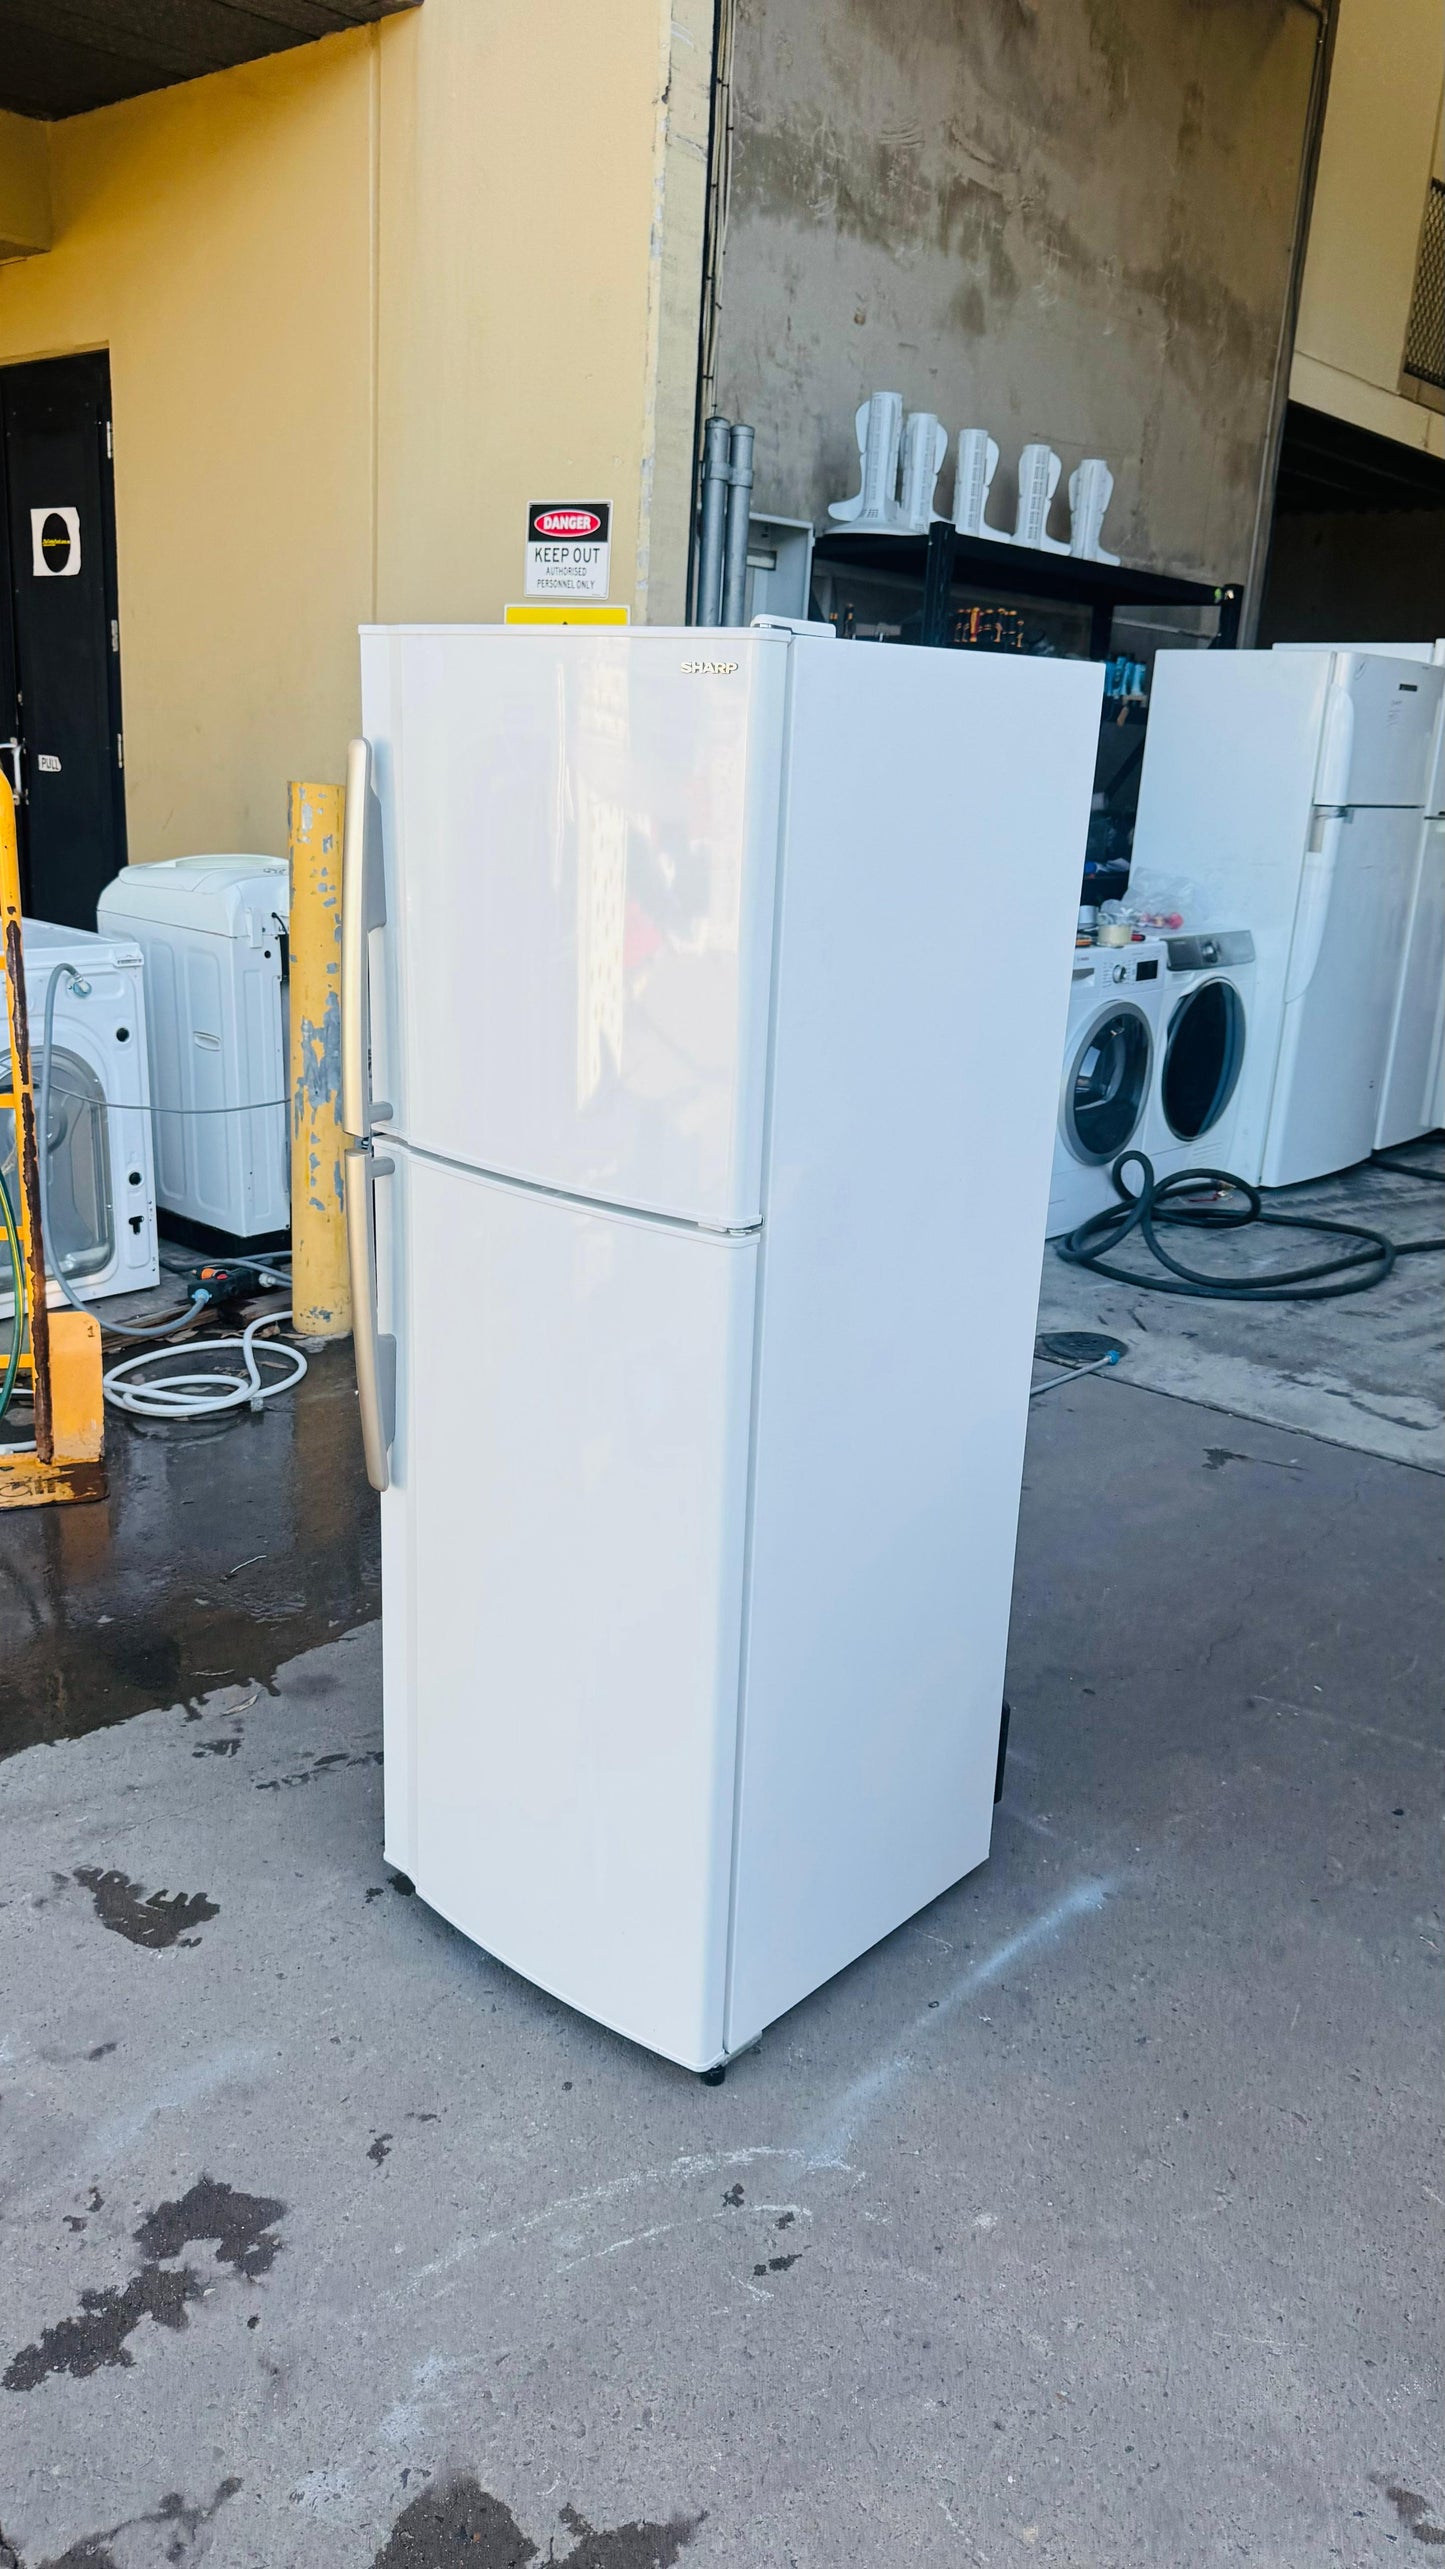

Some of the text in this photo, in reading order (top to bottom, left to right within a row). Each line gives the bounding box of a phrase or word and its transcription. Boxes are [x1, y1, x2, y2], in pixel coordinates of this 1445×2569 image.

[543, 516, 591, 530] DANGER
[534, 547, 600, 563] KEEP OUT
[545, 567, 587, 577] AUTHORISED
[537, 579, 596, 590] PERSONNEL ONLY
[680, 661, 739, 675] SHARP
[41, 757, 59, 770] PULL
